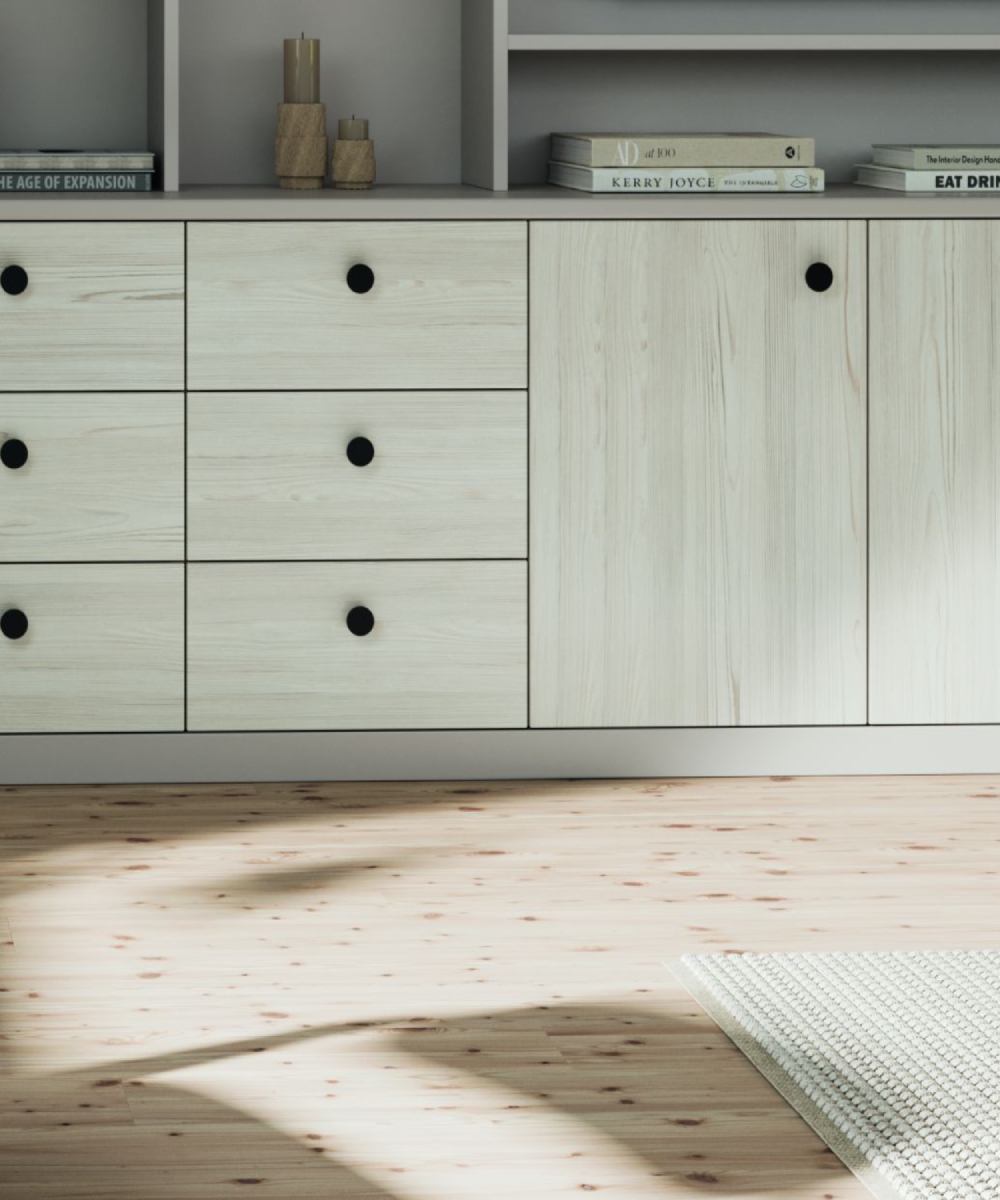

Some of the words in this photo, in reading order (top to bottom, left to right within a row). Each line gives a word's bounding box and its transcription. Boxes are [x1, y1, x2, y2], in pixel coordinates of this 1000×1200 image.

[645, 148, 654, 159] at
[926, 155, 937, 164] The
[938, 155, 961, 164] Interior
[962, 155, 983, 165] Design
[0, 175, 13, 189] HE
[16, 175, 41, 189] AGE
[44, 175, 60, 189] OF
[64, 175, 136, 189] EXPANSION
[612, 177, 662, 188] KERRY
[669, 177, 716, 189] JOYCE
[935, 175, 962, 188] EAT
